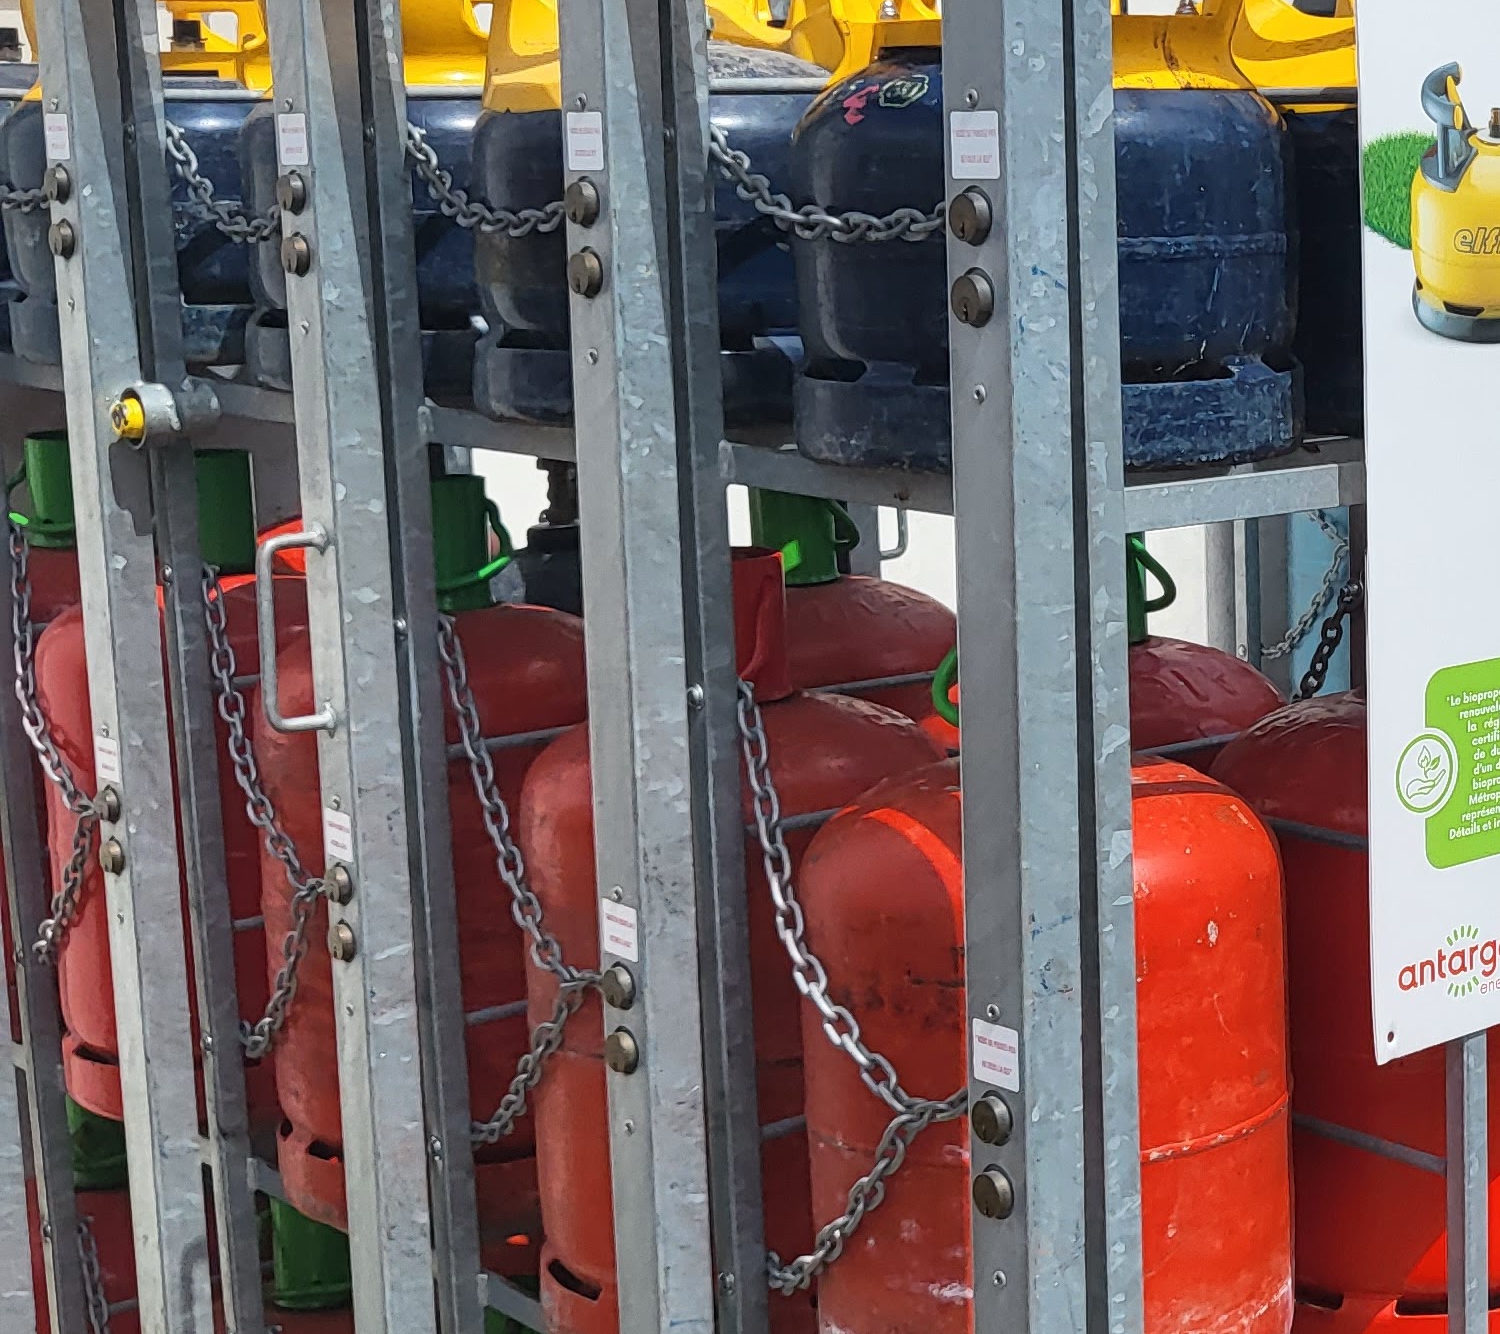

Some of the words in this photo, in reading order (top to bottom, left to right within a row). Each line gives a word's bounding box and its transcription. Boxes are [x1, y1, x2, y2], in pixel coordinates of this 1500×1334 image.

[1467, 720, 1477, 732] la
[1473, 747, 1486, 760] de
[1449, 821, 1481, 840] Détails
[1482, 818, 1492, 831] et
